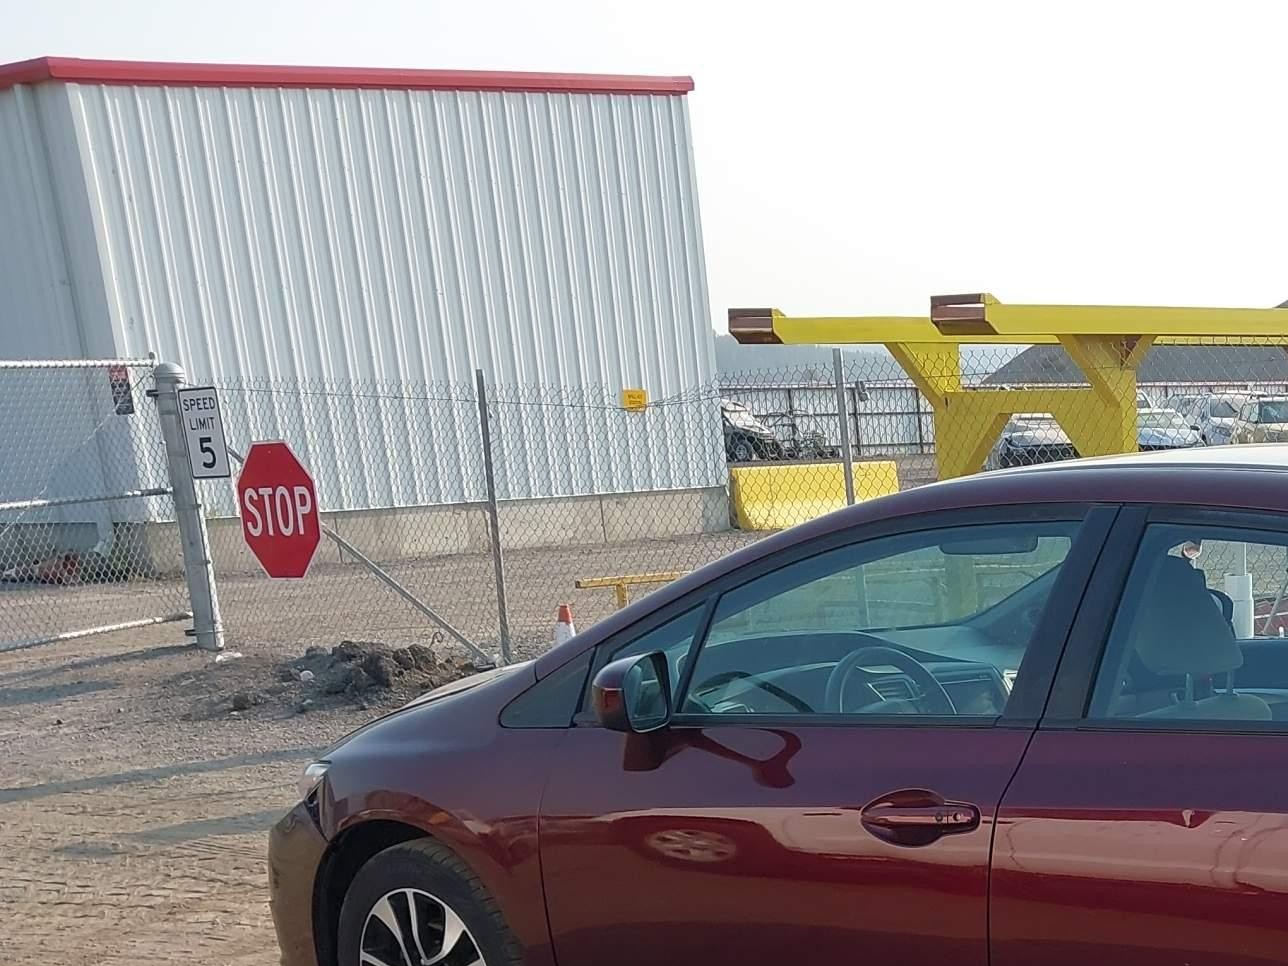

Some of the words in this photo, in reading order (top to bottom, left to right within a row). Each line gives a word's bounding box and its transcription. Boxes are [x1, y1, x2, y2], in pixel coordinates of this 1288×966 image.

[183, 396, 216, 411] SPEED
[189, 416, 215, 431] LIMIT
[199, 436, 217, 469] 5
[243, 485, 312, 537] STOP
